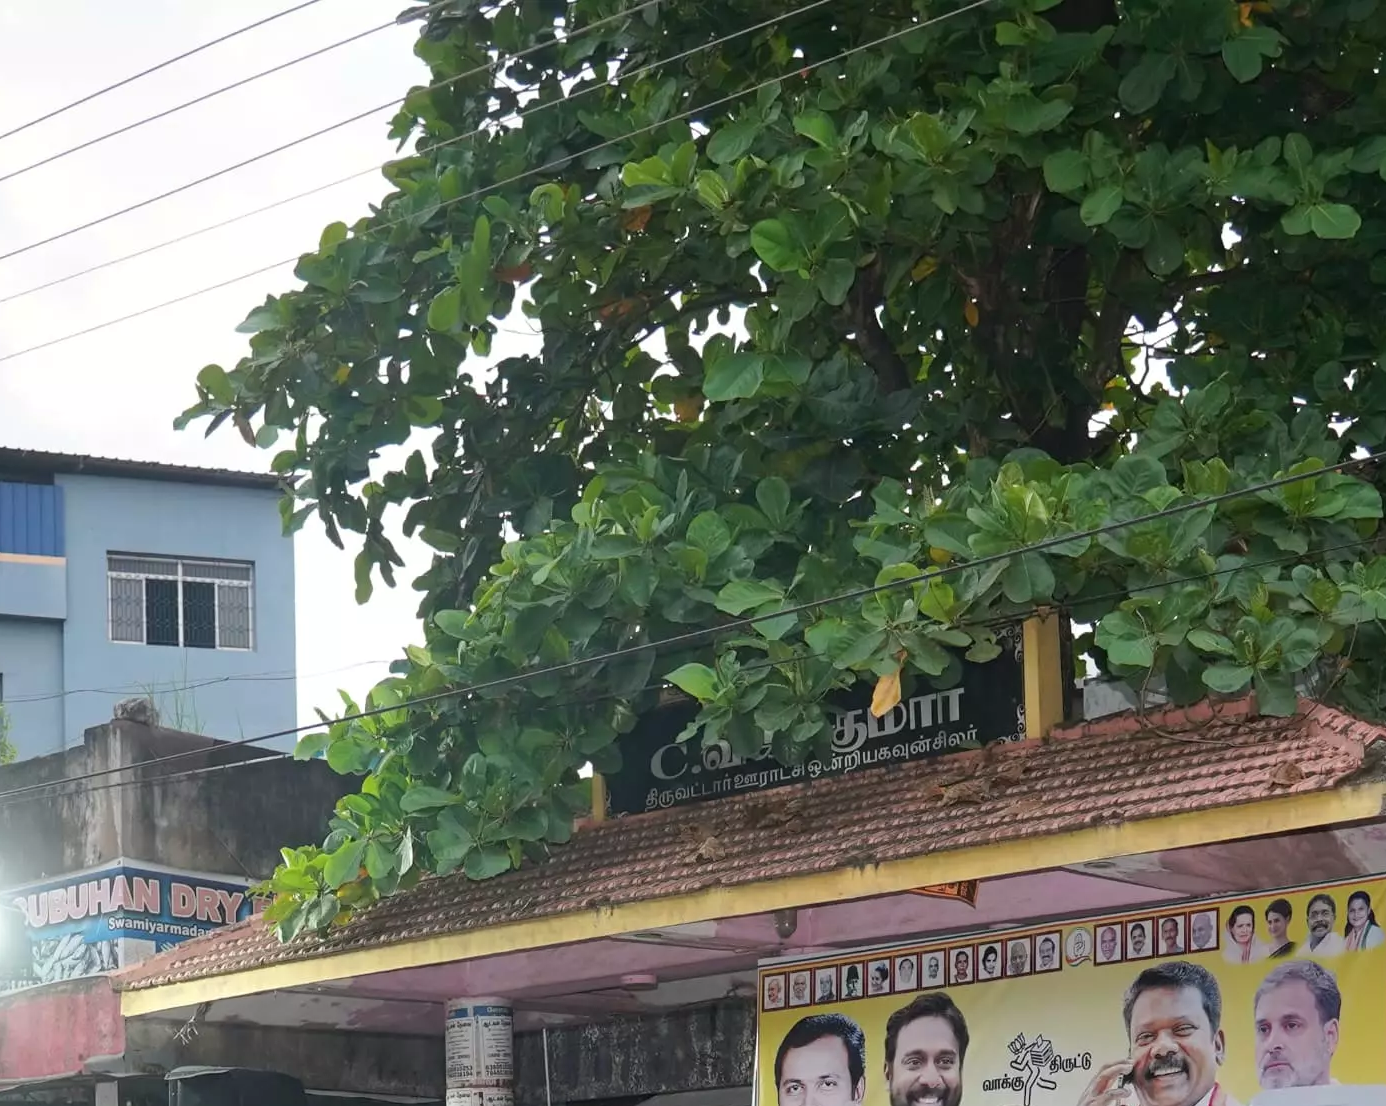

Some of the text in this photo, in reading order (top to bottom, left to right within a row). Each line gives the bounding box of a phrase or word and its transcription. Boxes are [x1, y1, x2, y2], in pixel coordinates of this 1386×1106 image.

[170, 882, 245, 924] DRY
[1050, 1052, 1092, 1074] திருட்டு
[982, 1074, 1025, 1091] வாக்கு
